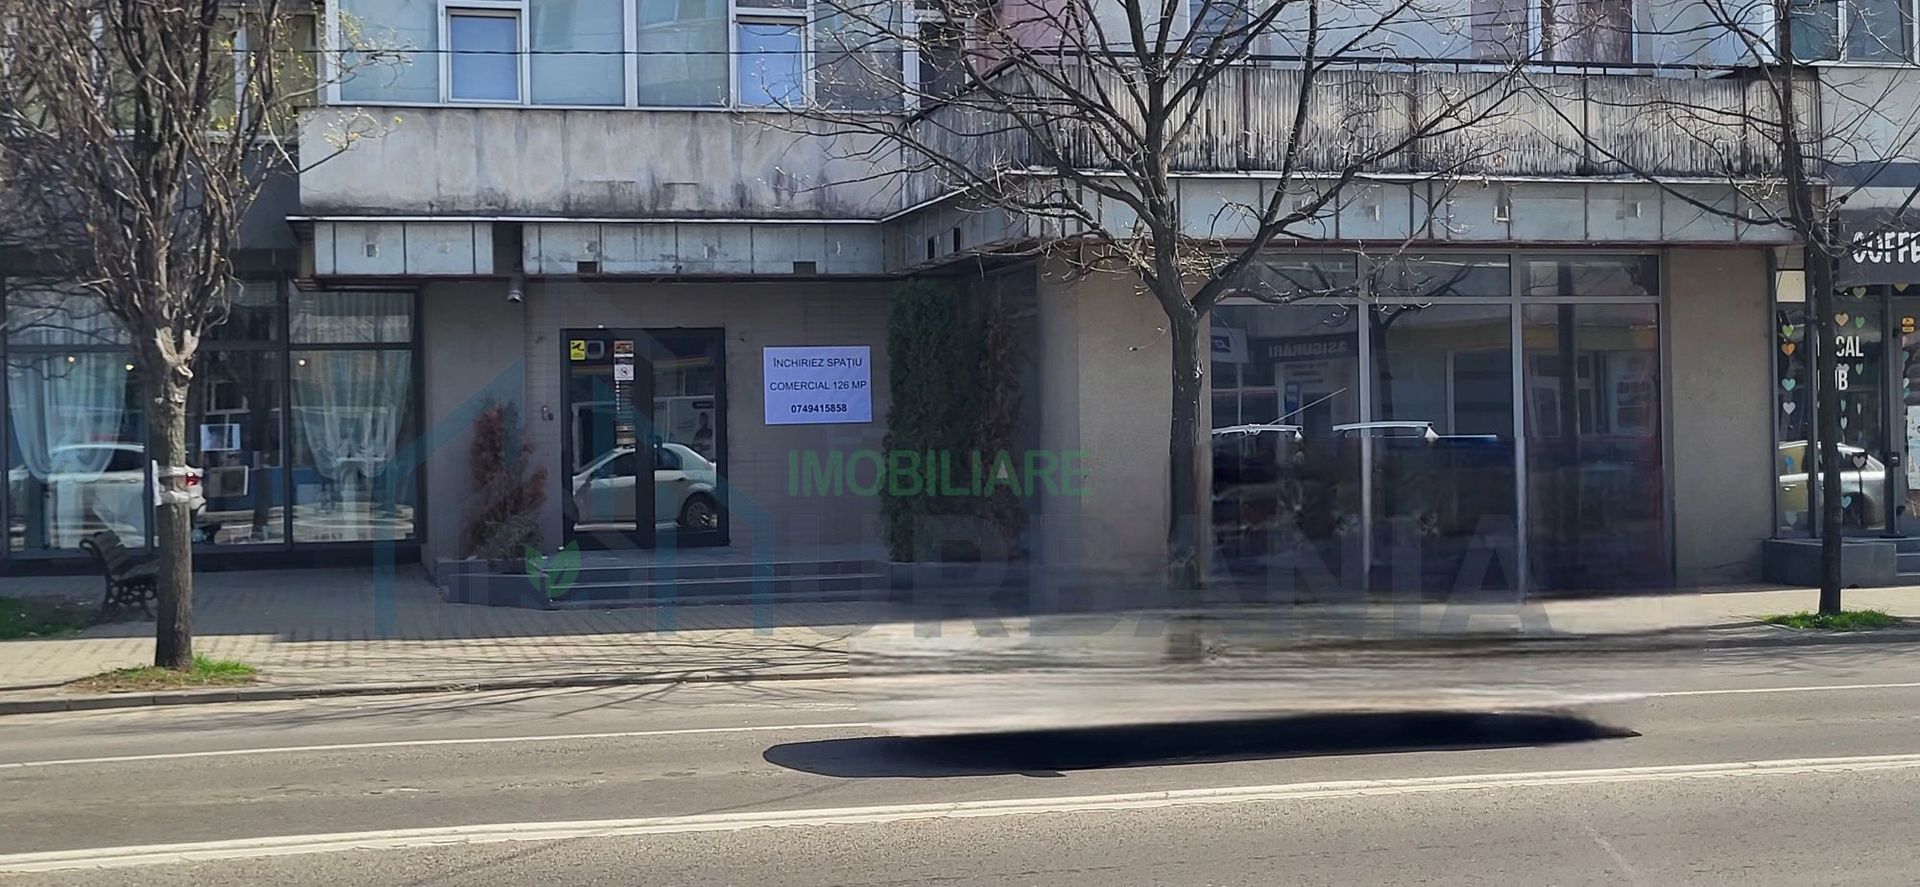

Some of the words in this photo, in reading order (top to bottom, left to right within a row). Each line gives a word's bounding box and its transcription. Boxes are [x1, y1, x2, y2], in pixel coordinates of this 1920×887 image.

[773, 357, 825, 368] ÎNCHIRIEZ
[769, 381, 830, 391] COMERCIAL
[833, 380, 850, 390] 126
[851, 380, 867, 390] MP
[791, 403, 848, 414] 0749415858
